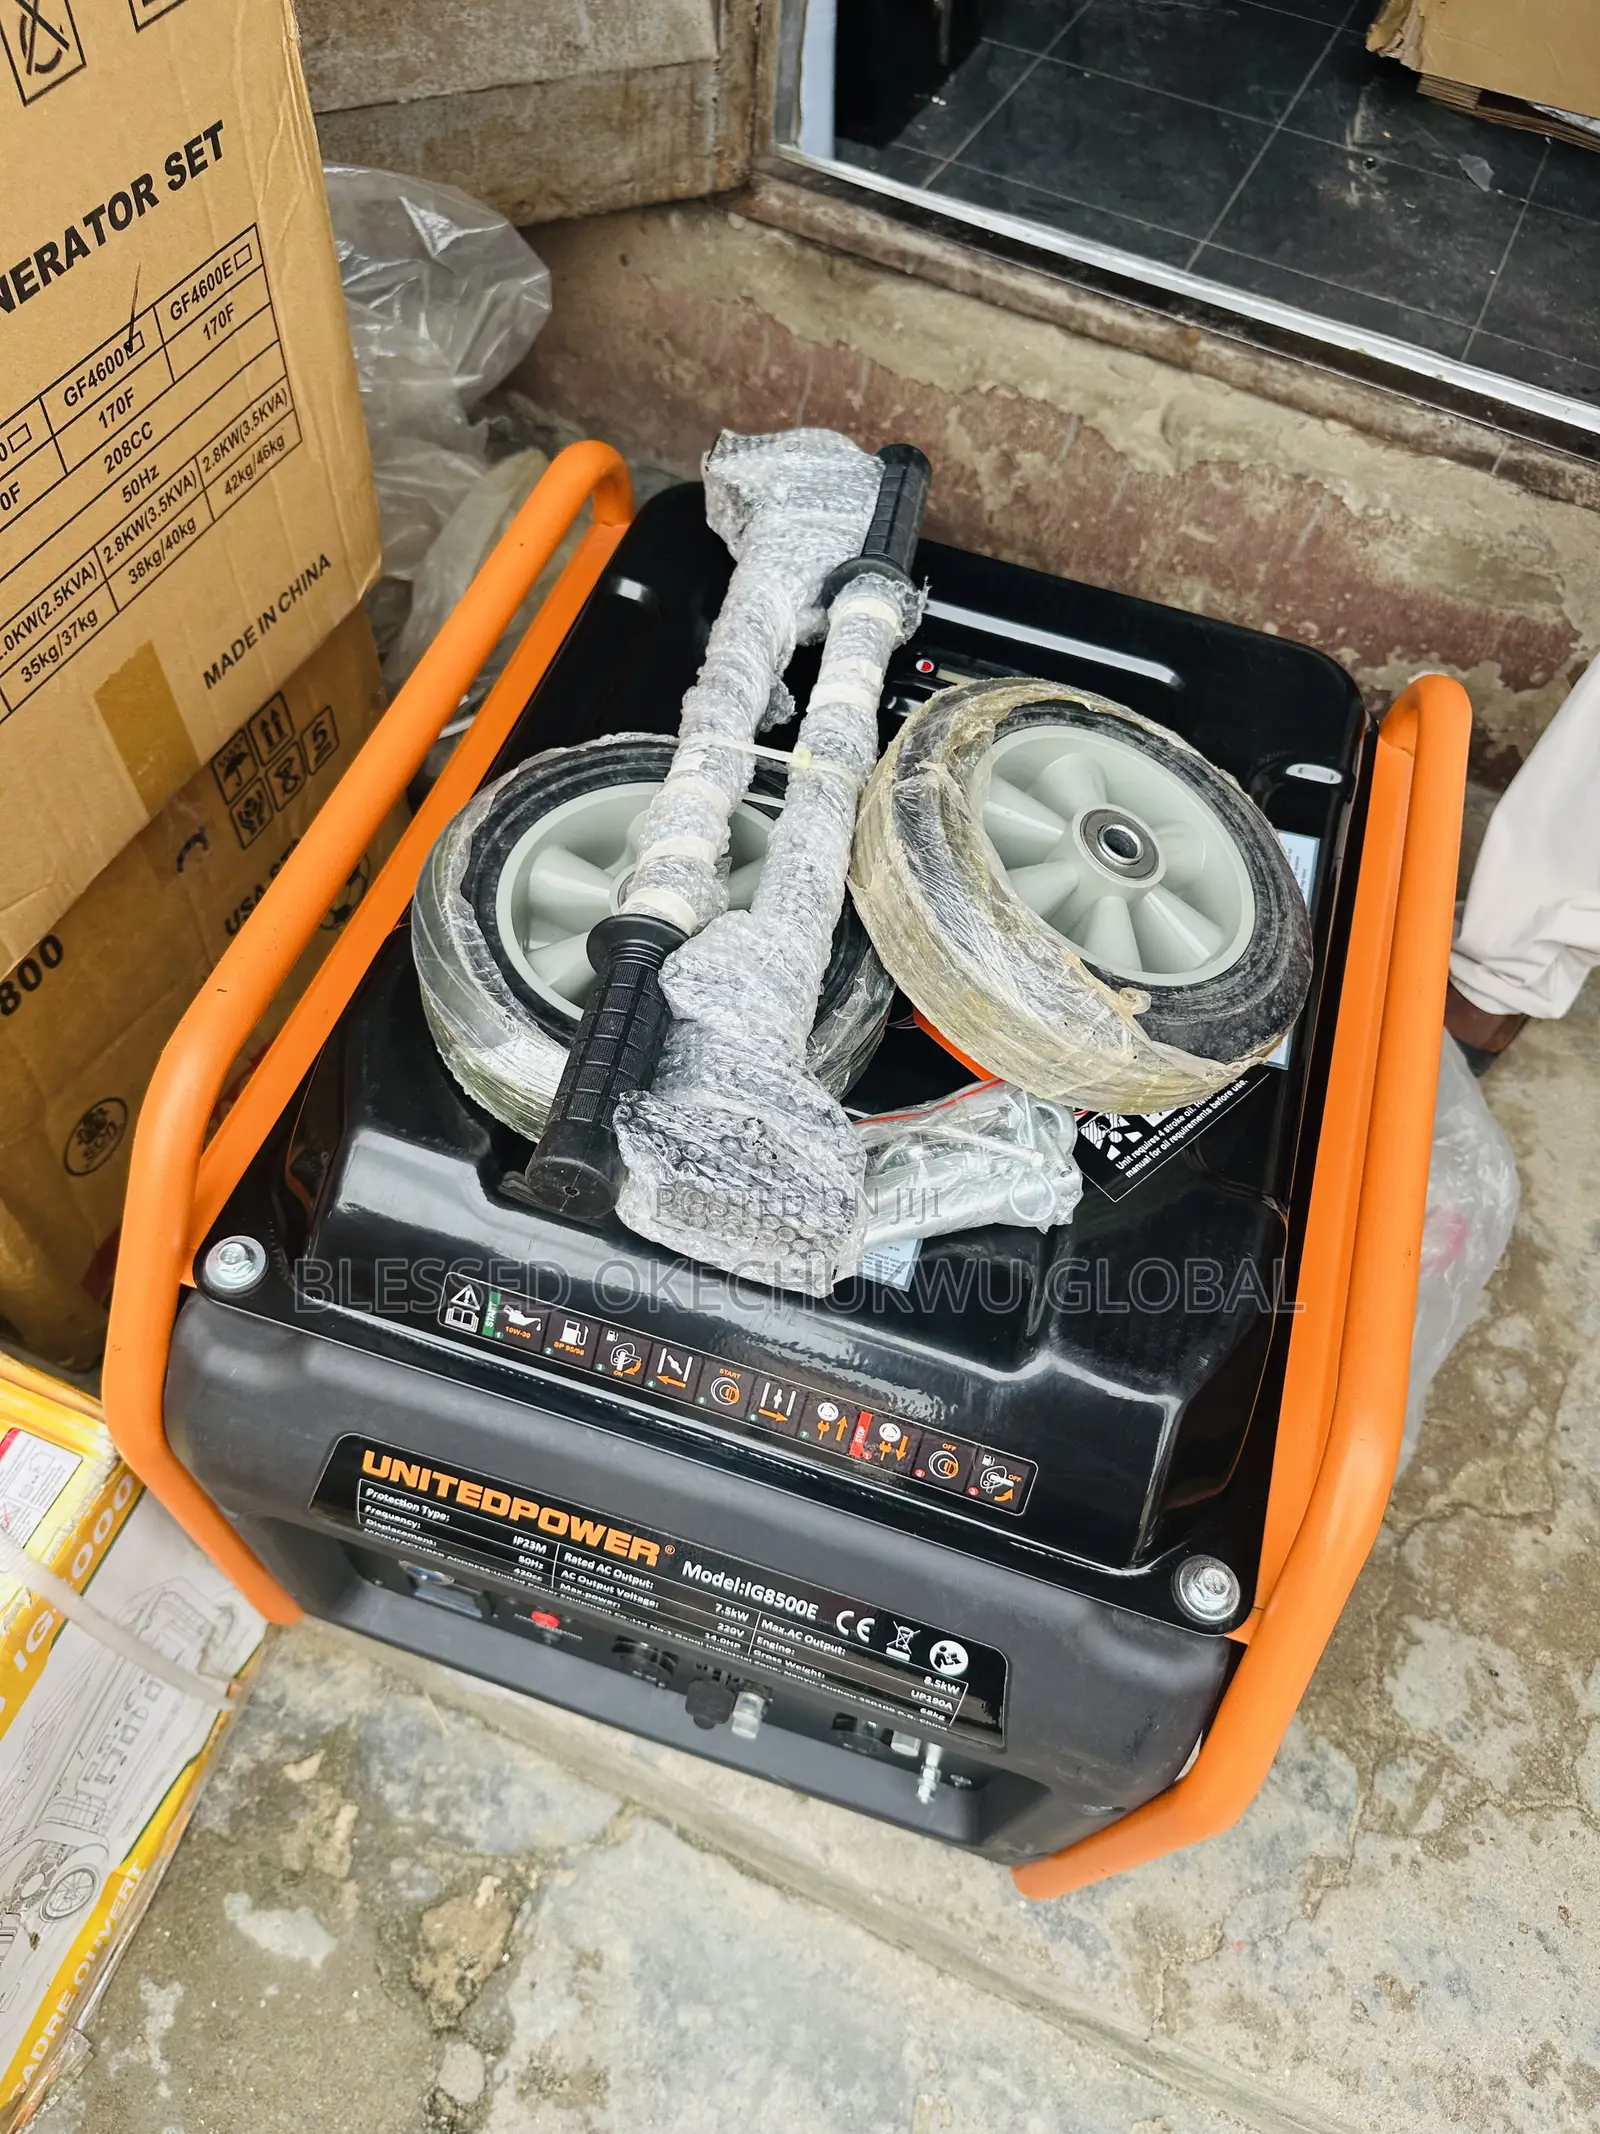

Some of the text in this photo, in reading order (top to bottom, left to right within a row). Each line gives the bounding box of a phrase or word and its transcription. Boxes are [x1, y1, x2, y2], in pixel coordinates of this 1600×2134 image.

[165, 120, 223, 192] SET
[170, 257, 233, 321] GF4600E
[203, 303, 236, 341] 170F
[63, 347, 125, 408] GF4600
[99, 387, 136, 430] 170F
[104, 421, 154, 475] 208CC
[202, 387, 288, 473] 2.8KW(3.5KVA)
[122, 463, 160, 504] 50Hz
[224, 433, 285, 497] 42kg/46kg
[103, 469, 198, 564] 2.8KW(3.5KVA)
[128, 516, 197, 585] 38kg/40kg
[0, 561, 98, 661] .0KW(2.5KVA)
[202, 553, 332, 690] MADE IN CHINA
[21, 608, 98, 683] 35kg/37kg
[1115, 1155, 1134, 1170] Unit
[1131, 1134, 1160, 1159] requires
[1158, 1129, 1166, 1137] 4
[1163, 1114, 1186, 1134] stroke
[1184, 1106, 1197, 1117] oil.
[1125, 1079, 1249, 1179] manual for oil requirements before use.
[484, 1301, 499, 1328] START
[504, 1325, 532, 1340] 10W-30
[719, 1367, 742, 1380] START
[854, 1425, 866, 1444] STOP
[942, 1442, 957, 1452] OFF
[364, 1504, 545, 1571] Frequency: 50Hz
[365, 1518, 437, 1547] Displacement:
[366, 1487, 548, 1554] Protection Type: IP23M
[560, 1569, 745, 1638] AC Output Voltage: 220V
[564, 1553, 750, 1623] Rated AC Output: 7.5kW
[682, 1560, 820, 1622] Model:IG8500E
[753, 1649, 782, 1665] Gross
[756, 1636, 796, 1657] Engine:
[761, 1619, 960, 1695] Max.AC Output: 8.5kW
